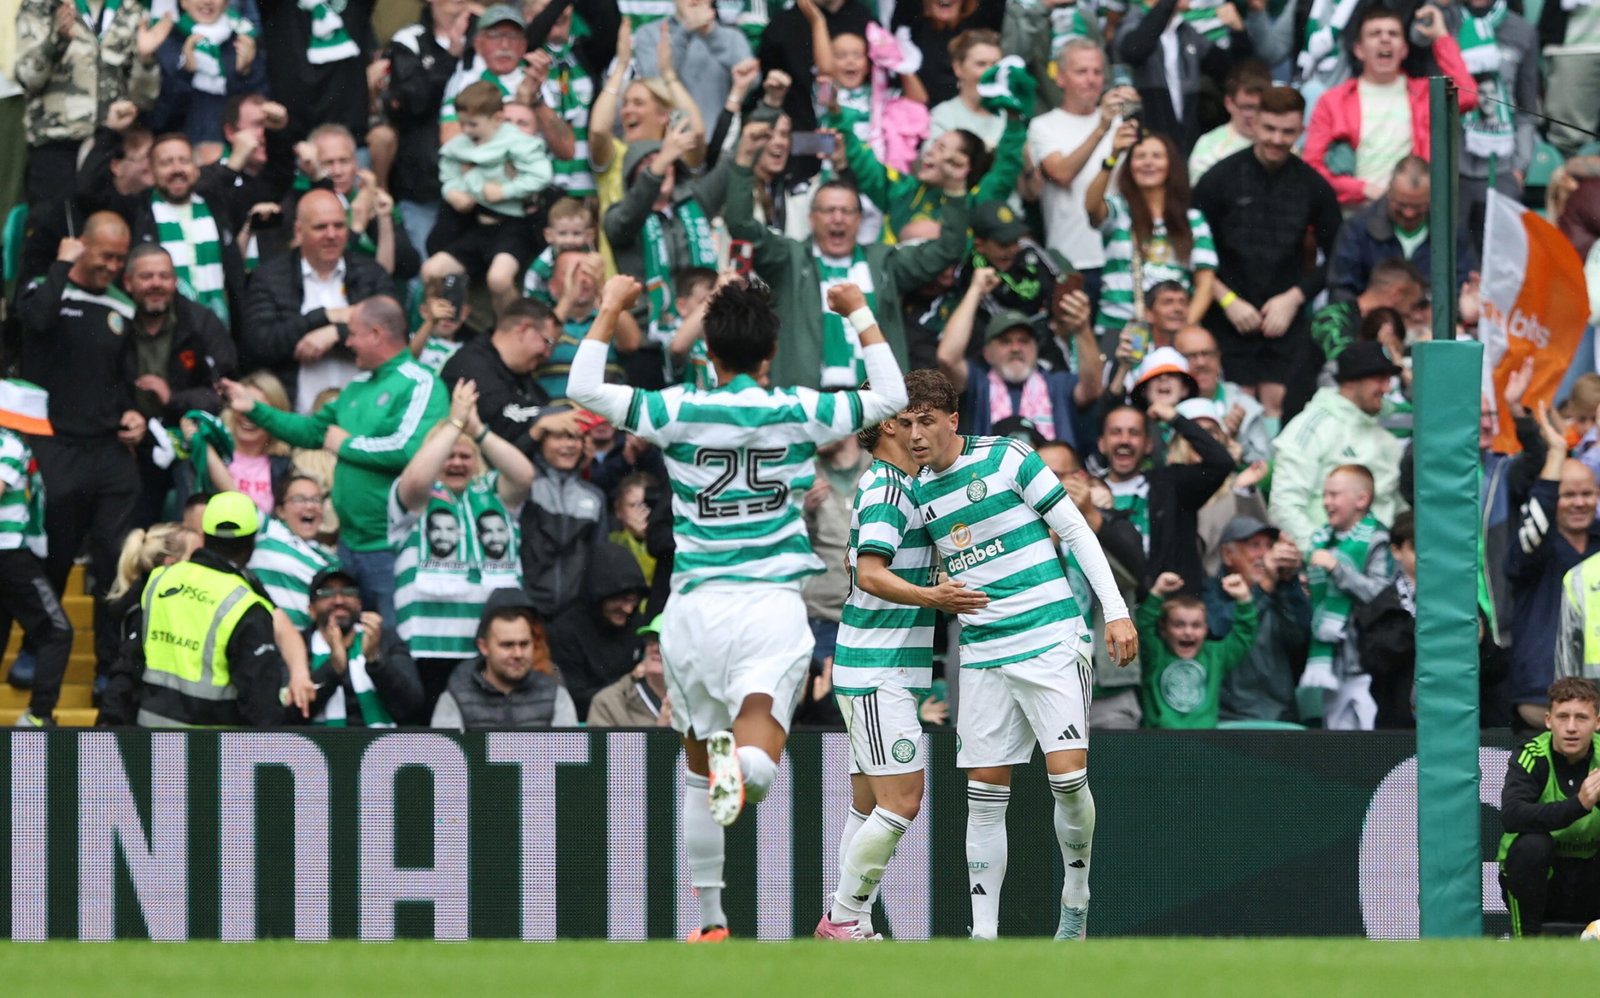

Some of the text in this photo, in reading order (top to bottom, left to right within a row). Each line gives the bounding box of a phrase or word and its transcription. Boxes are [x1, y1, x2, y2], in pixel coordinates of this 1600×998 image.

[696, 446, 788, 518] 25
[948, 538, 1005, 572] dafabet
[968, 861, 989, 869] ELTIC
